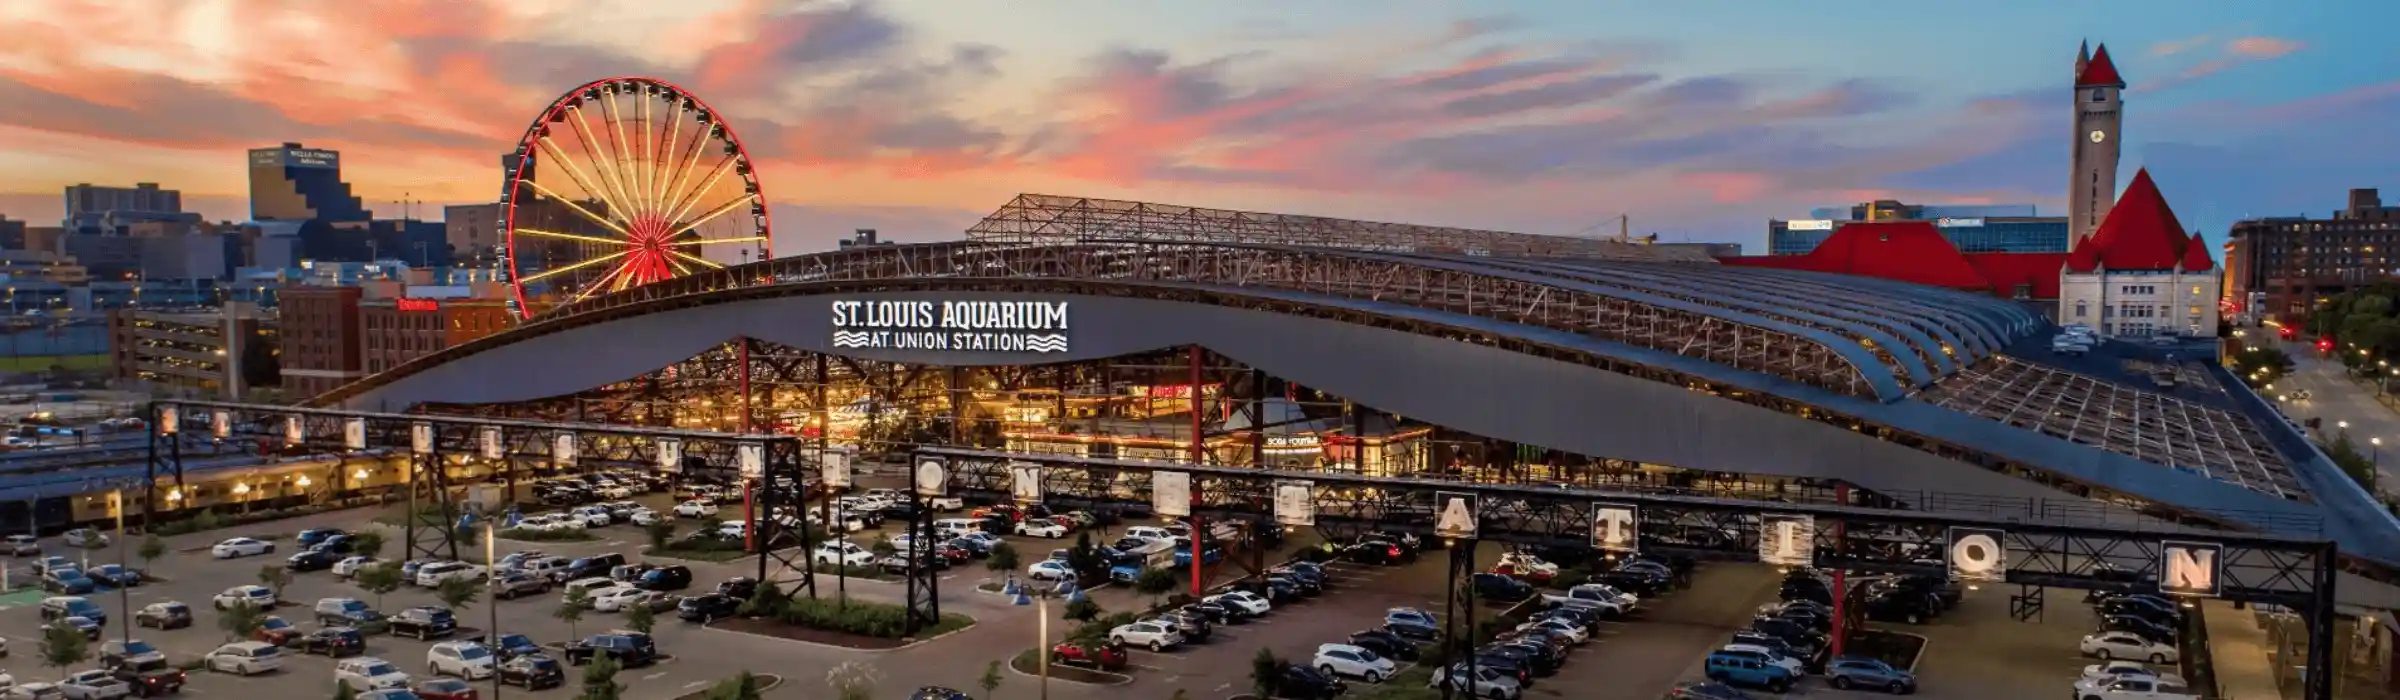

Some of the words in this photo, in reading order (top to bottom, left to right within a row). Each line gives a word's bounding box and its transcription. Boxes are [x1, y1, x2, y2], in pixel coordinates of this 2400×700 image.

[941, 300, 1068, 331] AQUARIUM
[870, 330, 890, 348] AT
[896, 331, 948, 350] UNION
[953, 332, 1025, 351] STATION
